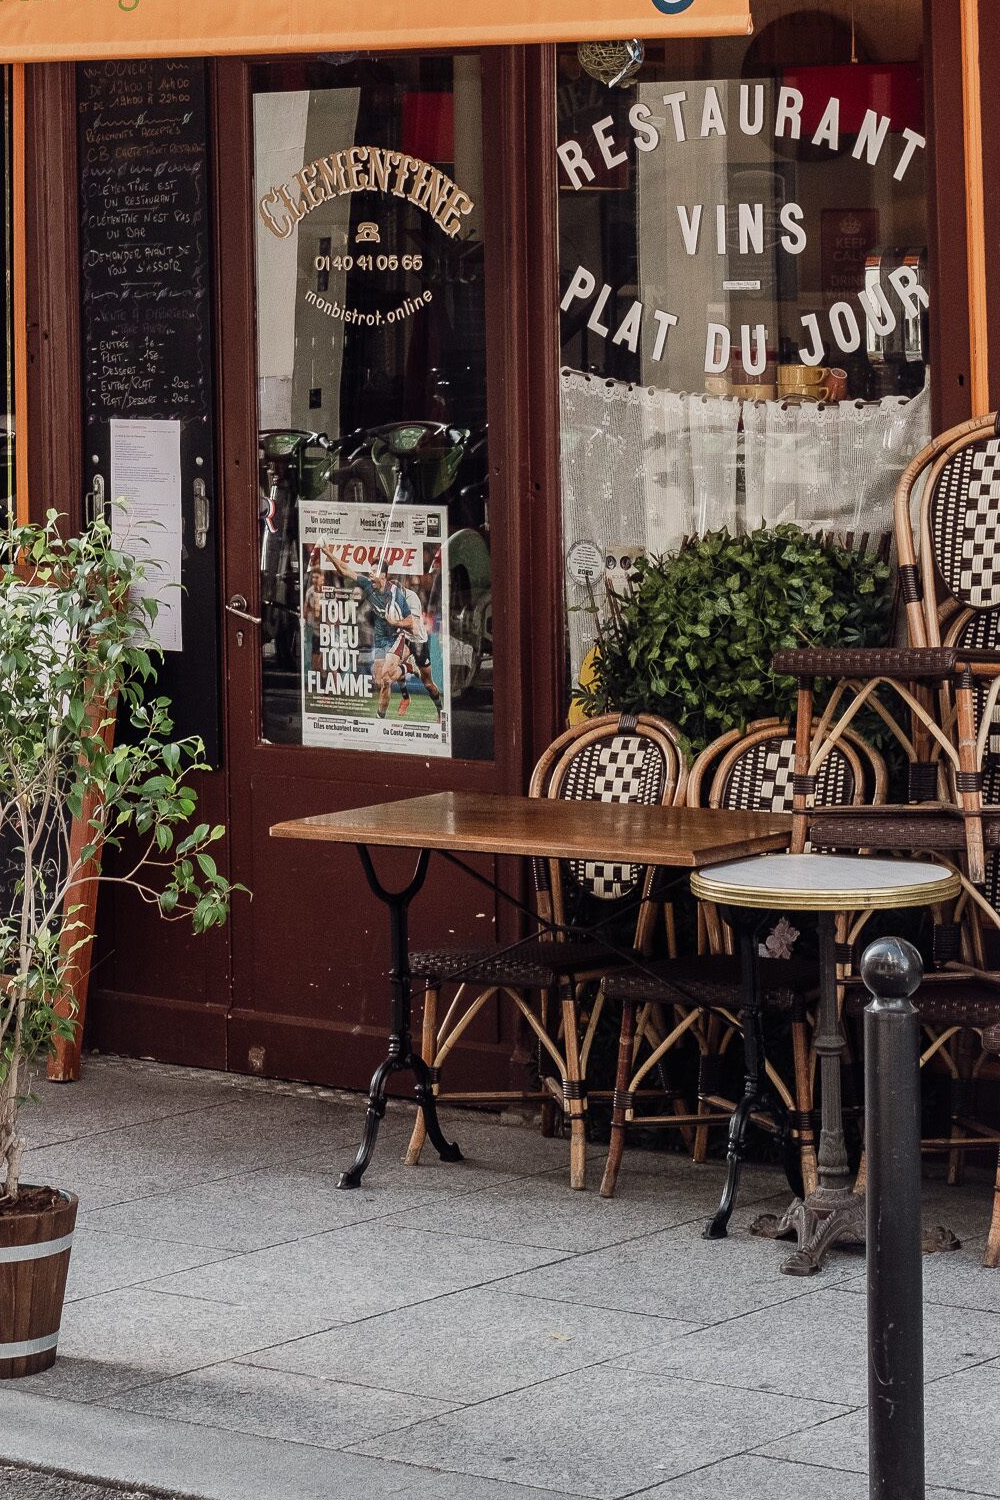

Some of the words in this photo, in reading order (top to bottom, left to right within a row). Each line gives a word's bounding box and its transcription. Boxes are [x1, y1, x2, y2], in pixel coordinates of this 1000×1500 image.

[557, 84, 926, 191] RESTAURANT
[157, 179, 178, 192] EST
[259, 146, 475, 239] CLEMENTINE
[104, 198, 119, 209] UN
[125, 192, 179, 206] RESTAURANT
[174, 209, 191, 224] PAS
[106, 229, 120, 240] UN
[677, 203, 807, 255] VINS
[88, 248, 142, 267] DEMANDER
[144, 246, 174, 260] AVANT
[315, 256, 330, 271] 01
[332, 256, 353, 271] 40
[357, 255, 373, 271] 41
[376, 255, 398, 271] 05
[402, 255, 423, 271] 65
[304, 289, 433, 326] monbistrot.online
[560, 265, 678, 362] PLAT
[704, 323, 767, 376] DU
[799, 265, 930, 367] JOUR
[319, 516, 341, 525] sommet
[360, 518, 377, 527] Messi
[387, 520, 405, 529] emet
[305, 526, 317, 535] pour
[577, 568, 594, 576] 2020
[320, 600, 359, 625] TOUT
[320, 624, 359, 649] BLEU
[320, 647, 359, 672] TOUT
[307, 670, 373, 698] FLAMME
[390, 729, 404, 737] Costa
[405, 730, 415, 738] seul
[423, 732, 439, 740] monde
